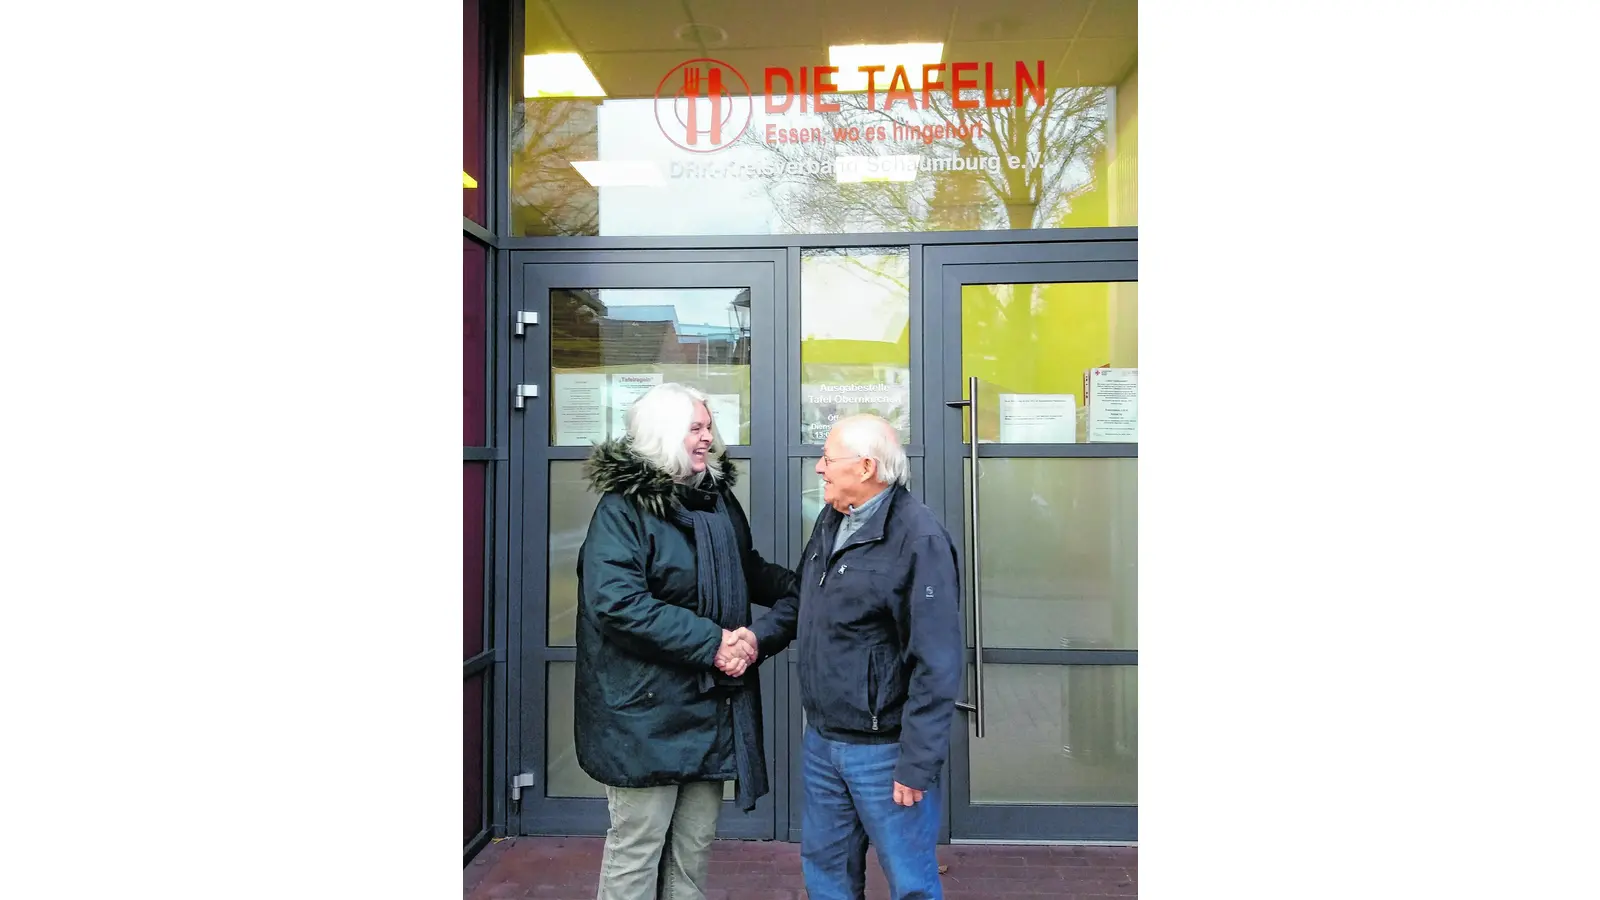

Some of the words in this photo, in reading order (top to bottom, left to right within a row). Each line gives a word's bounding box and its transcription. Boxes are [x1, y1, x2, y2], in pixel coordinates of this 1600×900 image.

[764, 66, 840, 113] DIE
[858, 60, 1045, 112] TAFELN
[765, 123, 827, 145] Essen,
[834, 127, 859, 142] wo
[864, 126, 886, 141] es
[894, 117, 983, 145] hingehört
[867, 154, 1001, 174] Schaumburg
[1007, 151, 1044, 170] e.V.
[808, 395, 831, 404] Tafel
[820, 383, 889, 393] Ausgabestelle
